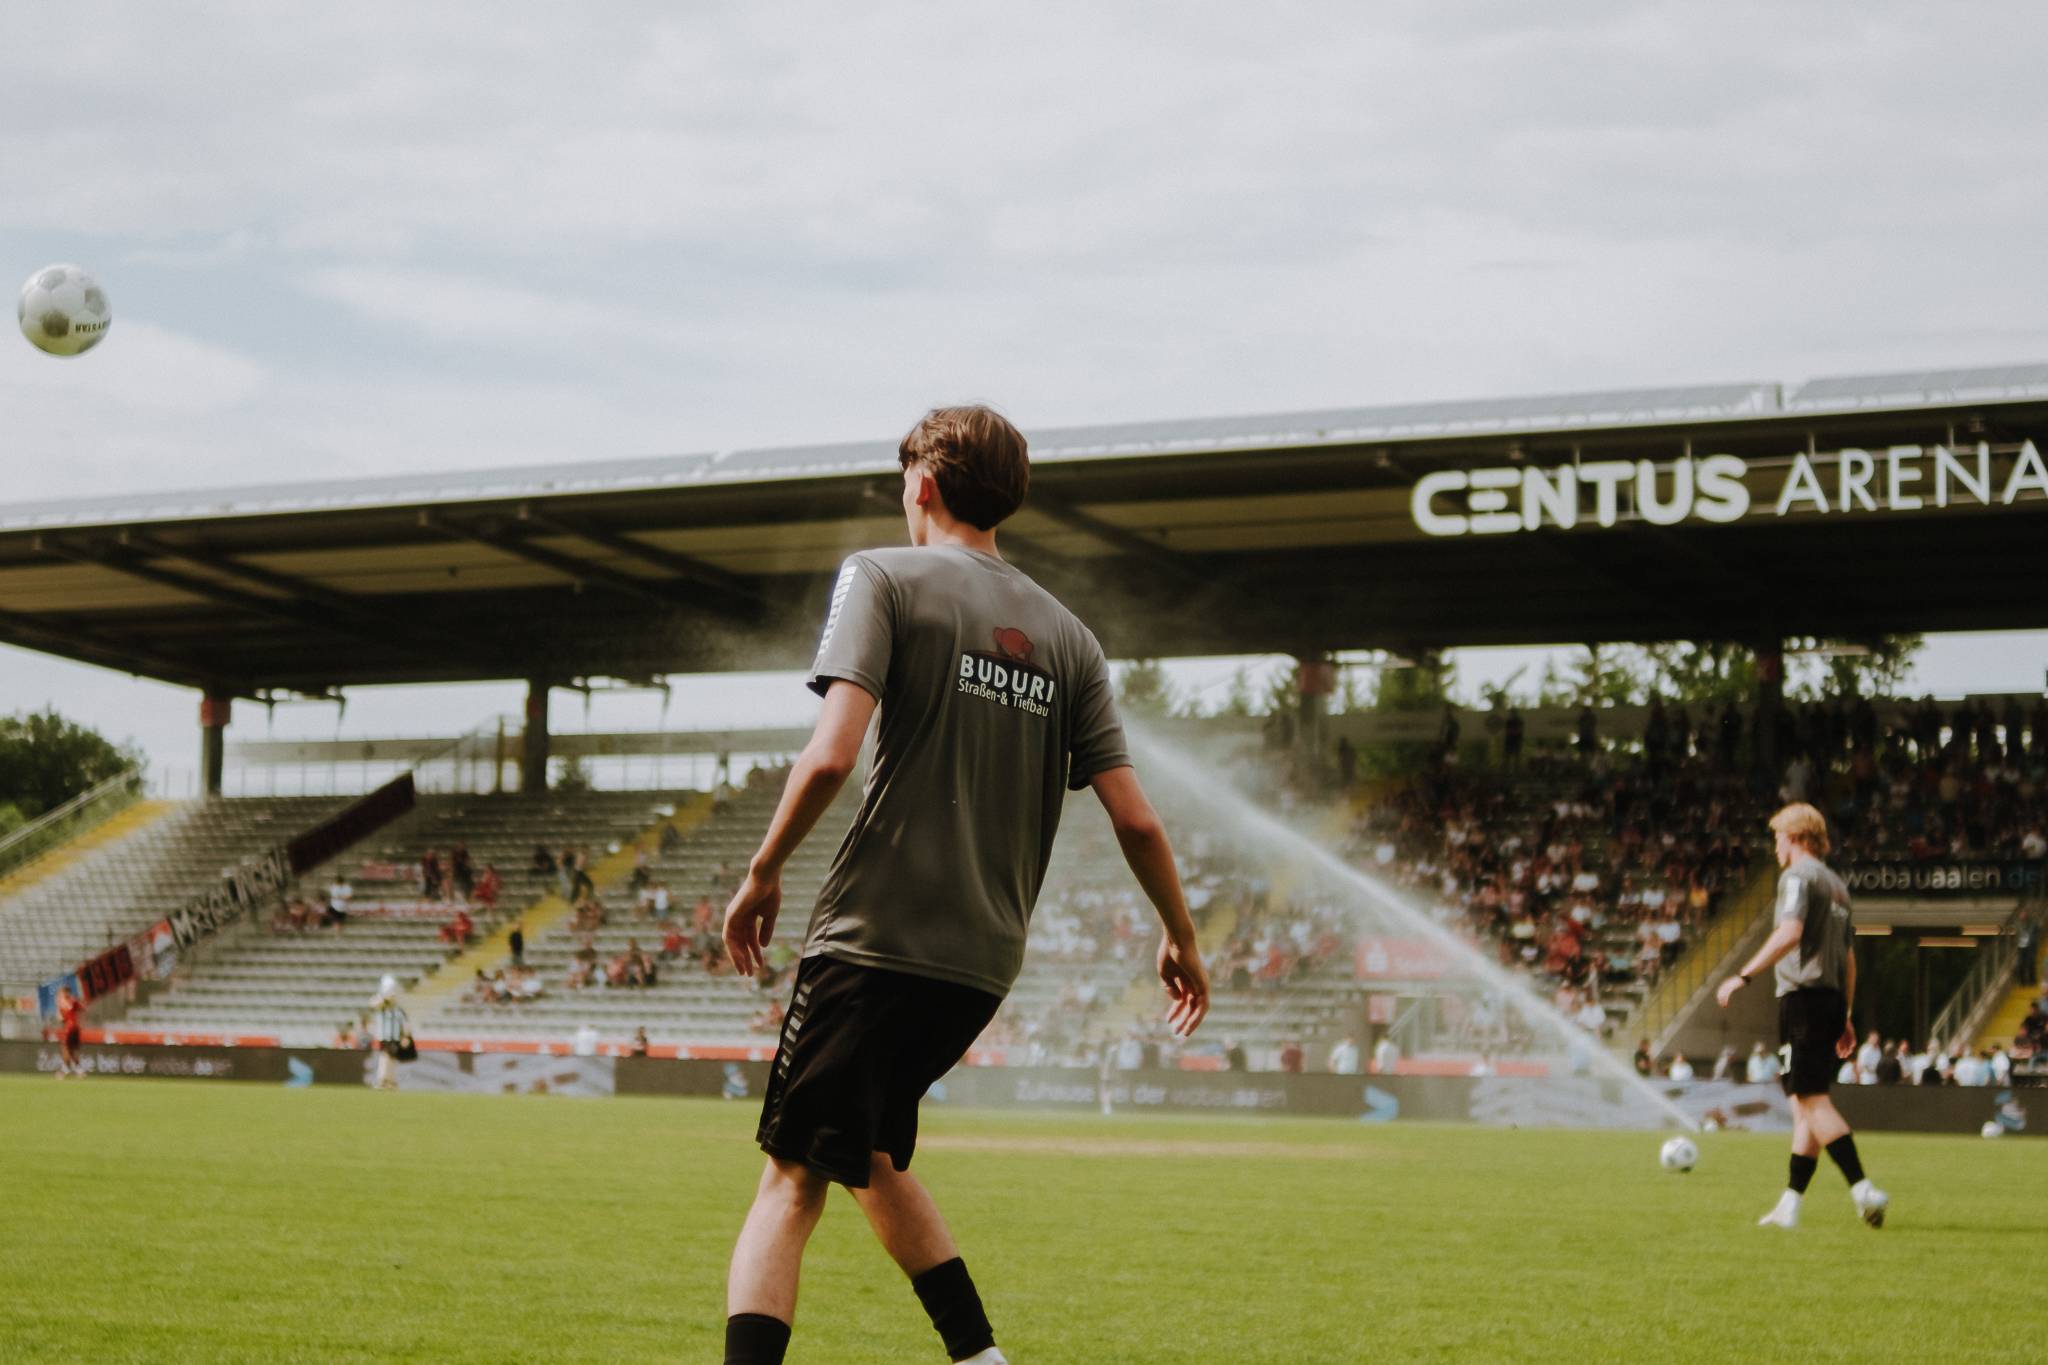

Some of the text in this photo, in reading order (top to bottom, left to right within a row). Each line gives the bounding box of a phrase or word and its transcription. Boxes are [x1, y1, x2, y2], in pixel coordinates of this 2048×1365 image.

[1411, 439, 2048, 537] CENTUS ARENA
[959, 653, 1055, 703] BUDURI
[1011, 692, 1050, 718] Tiefbau
